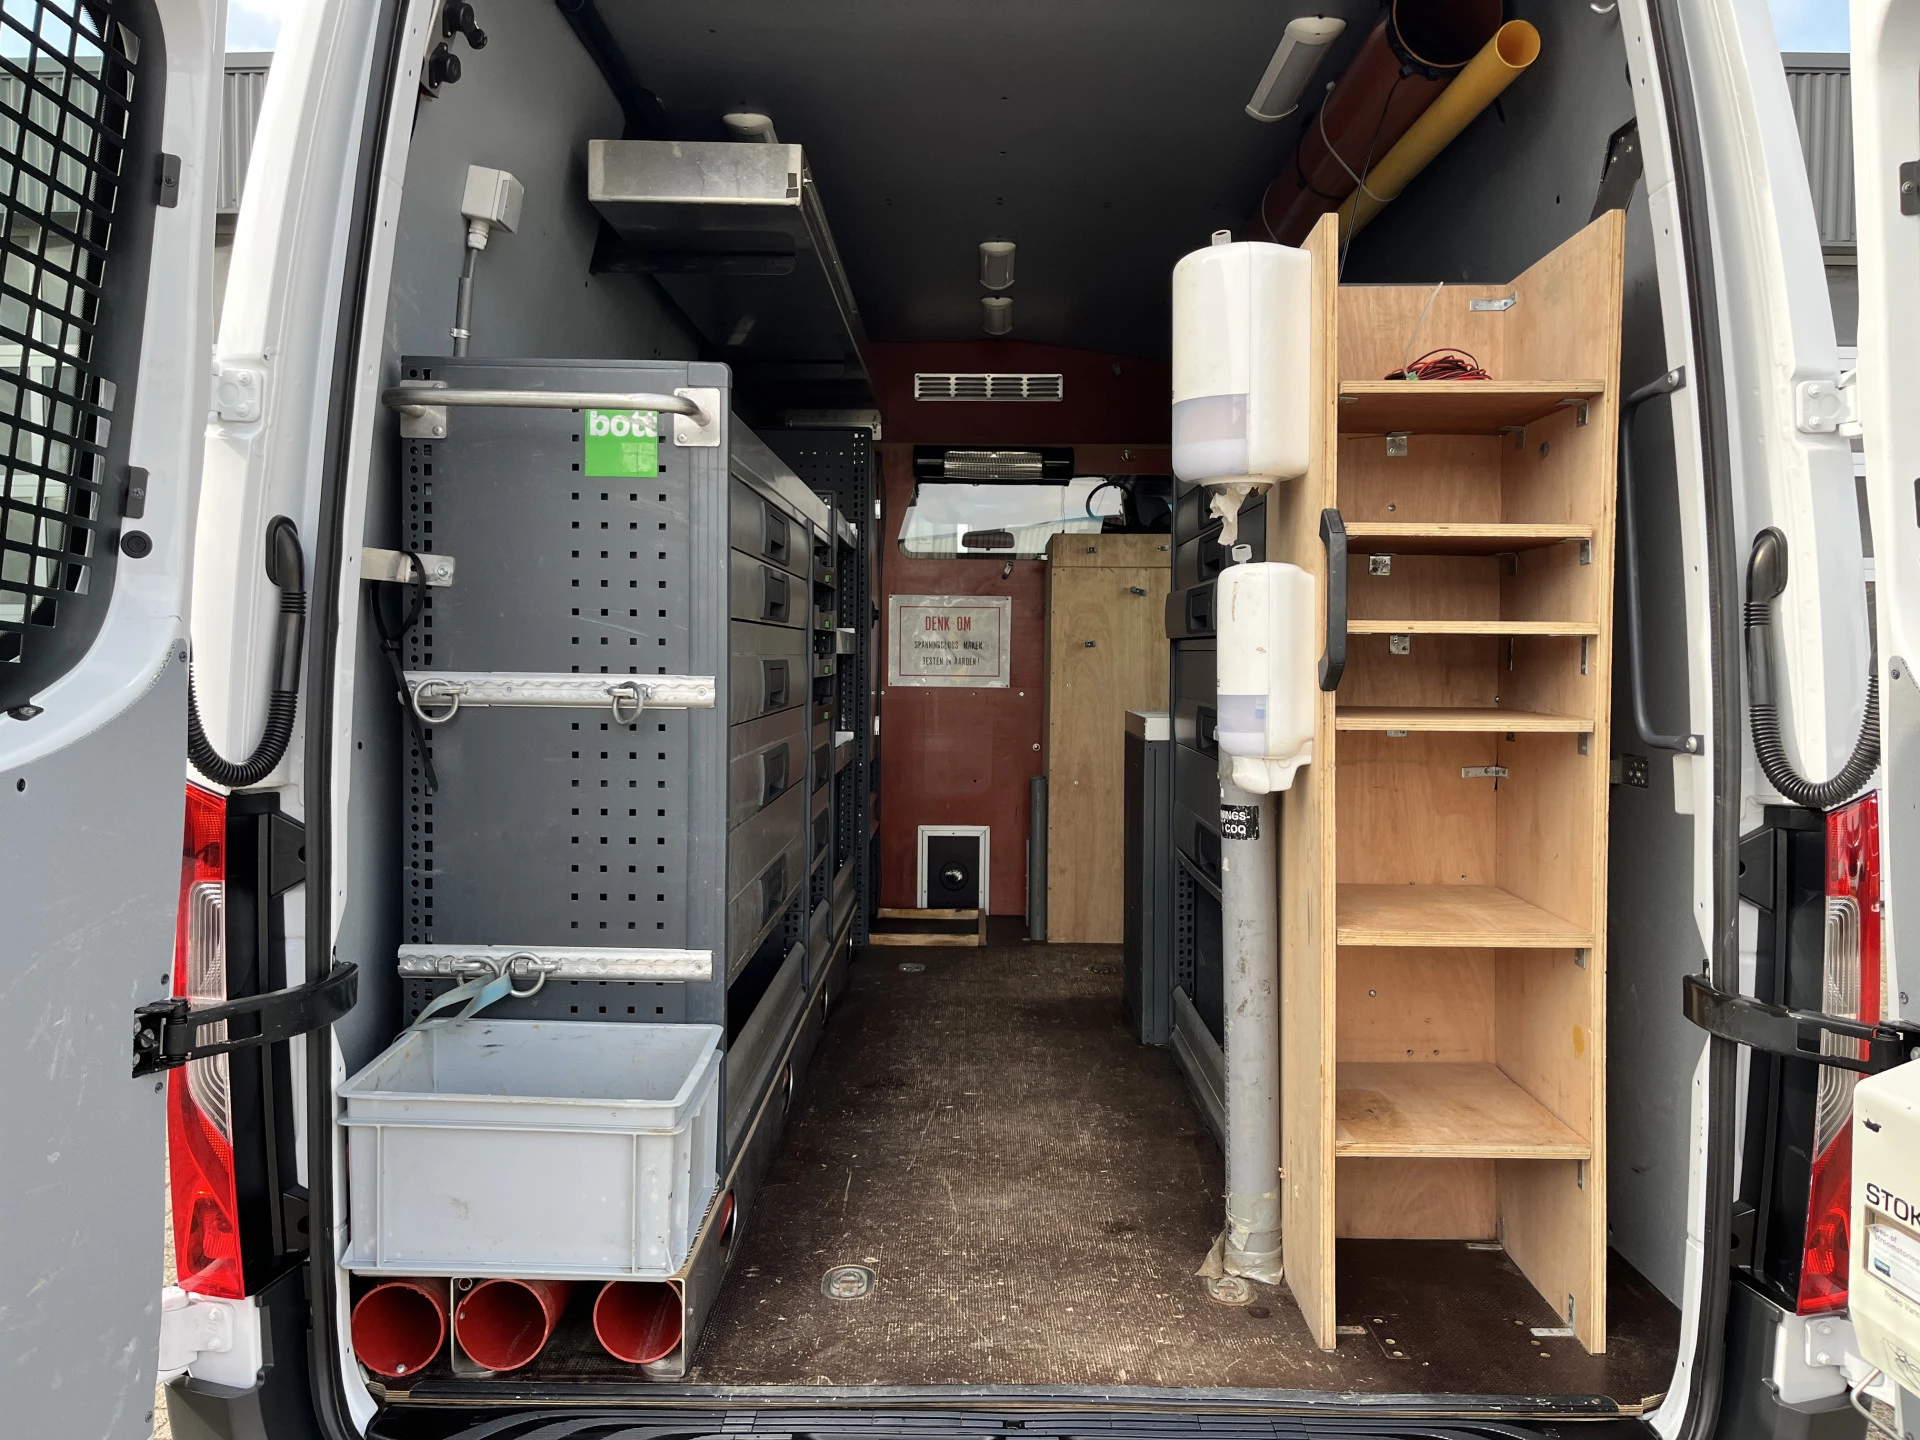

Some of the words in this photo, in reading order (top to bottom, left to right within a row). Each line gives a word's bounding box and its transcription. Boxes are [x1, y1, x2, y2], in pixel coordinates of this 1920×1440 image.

[589, 410, 658, 437] bott
[925, 616, 950, 631] DENK
[957, 616, 971, 631] OM
[922, 656, 943, 666] TESTEN
